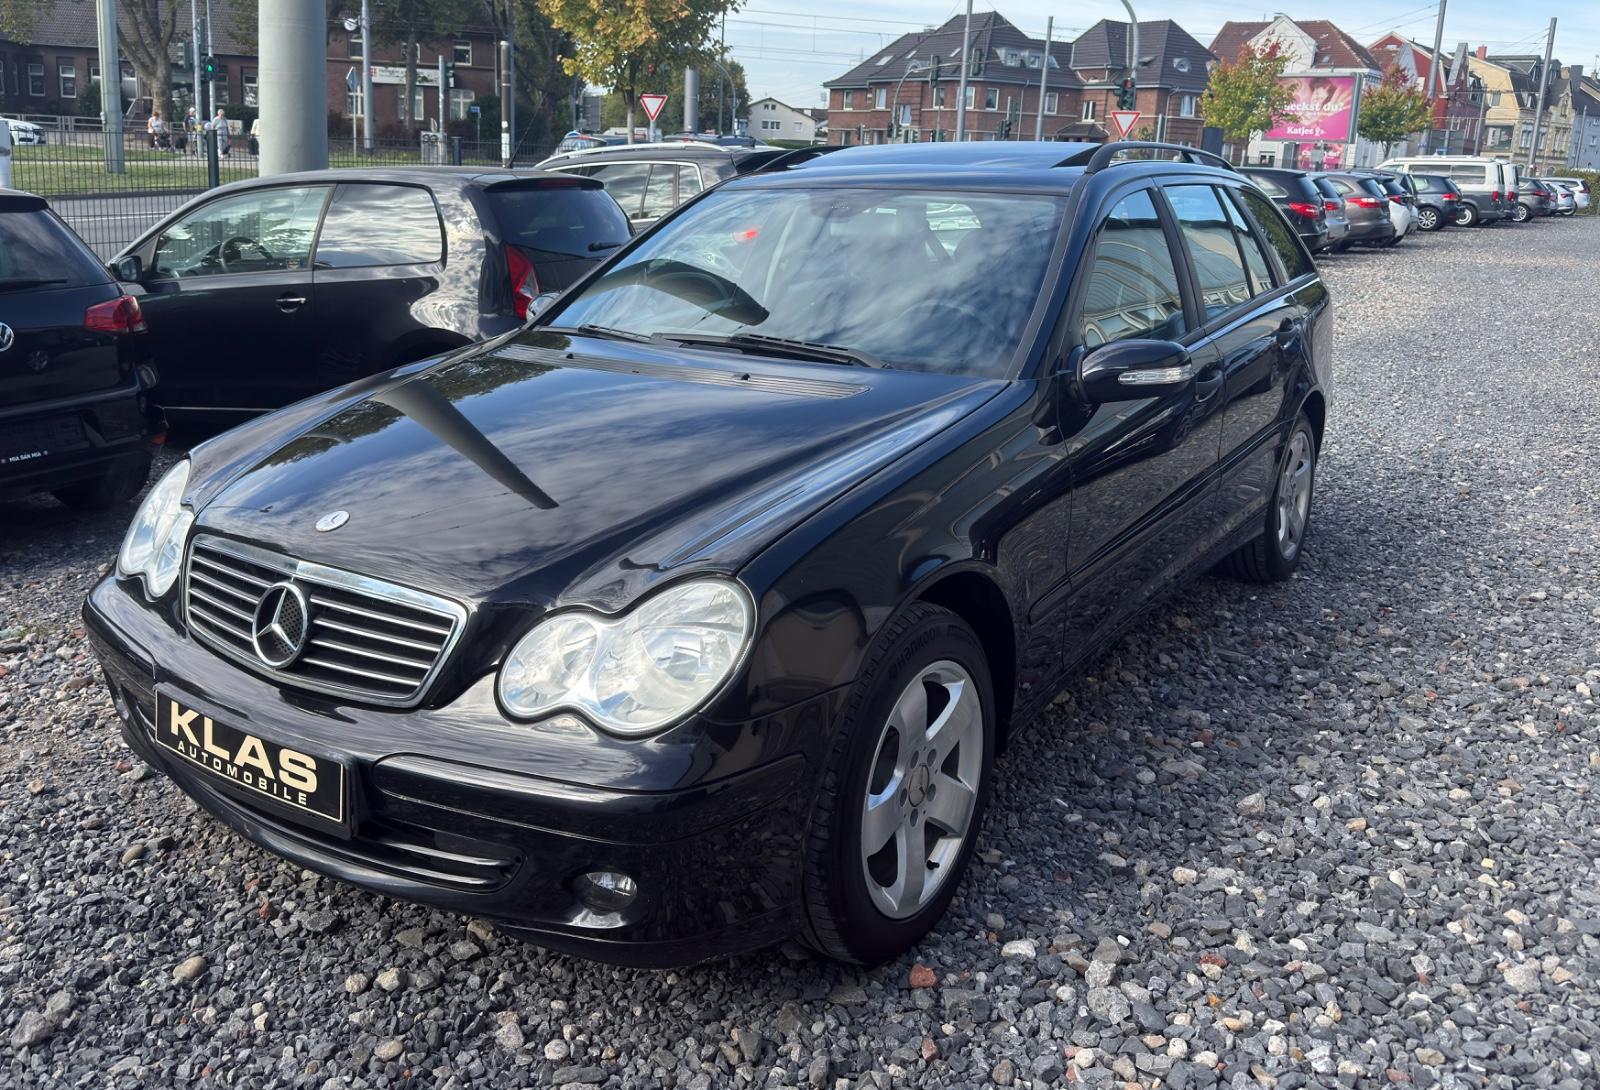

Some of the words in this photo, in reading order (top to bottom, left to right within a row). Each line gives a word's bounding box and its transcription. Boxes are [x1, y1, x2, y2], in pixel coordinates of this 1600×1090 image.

[1287, 126, 1314, 136] Katjes
[170, 701, 318, 794] KLAS
[178, 741, 307, 806] AUTOMOBILE
